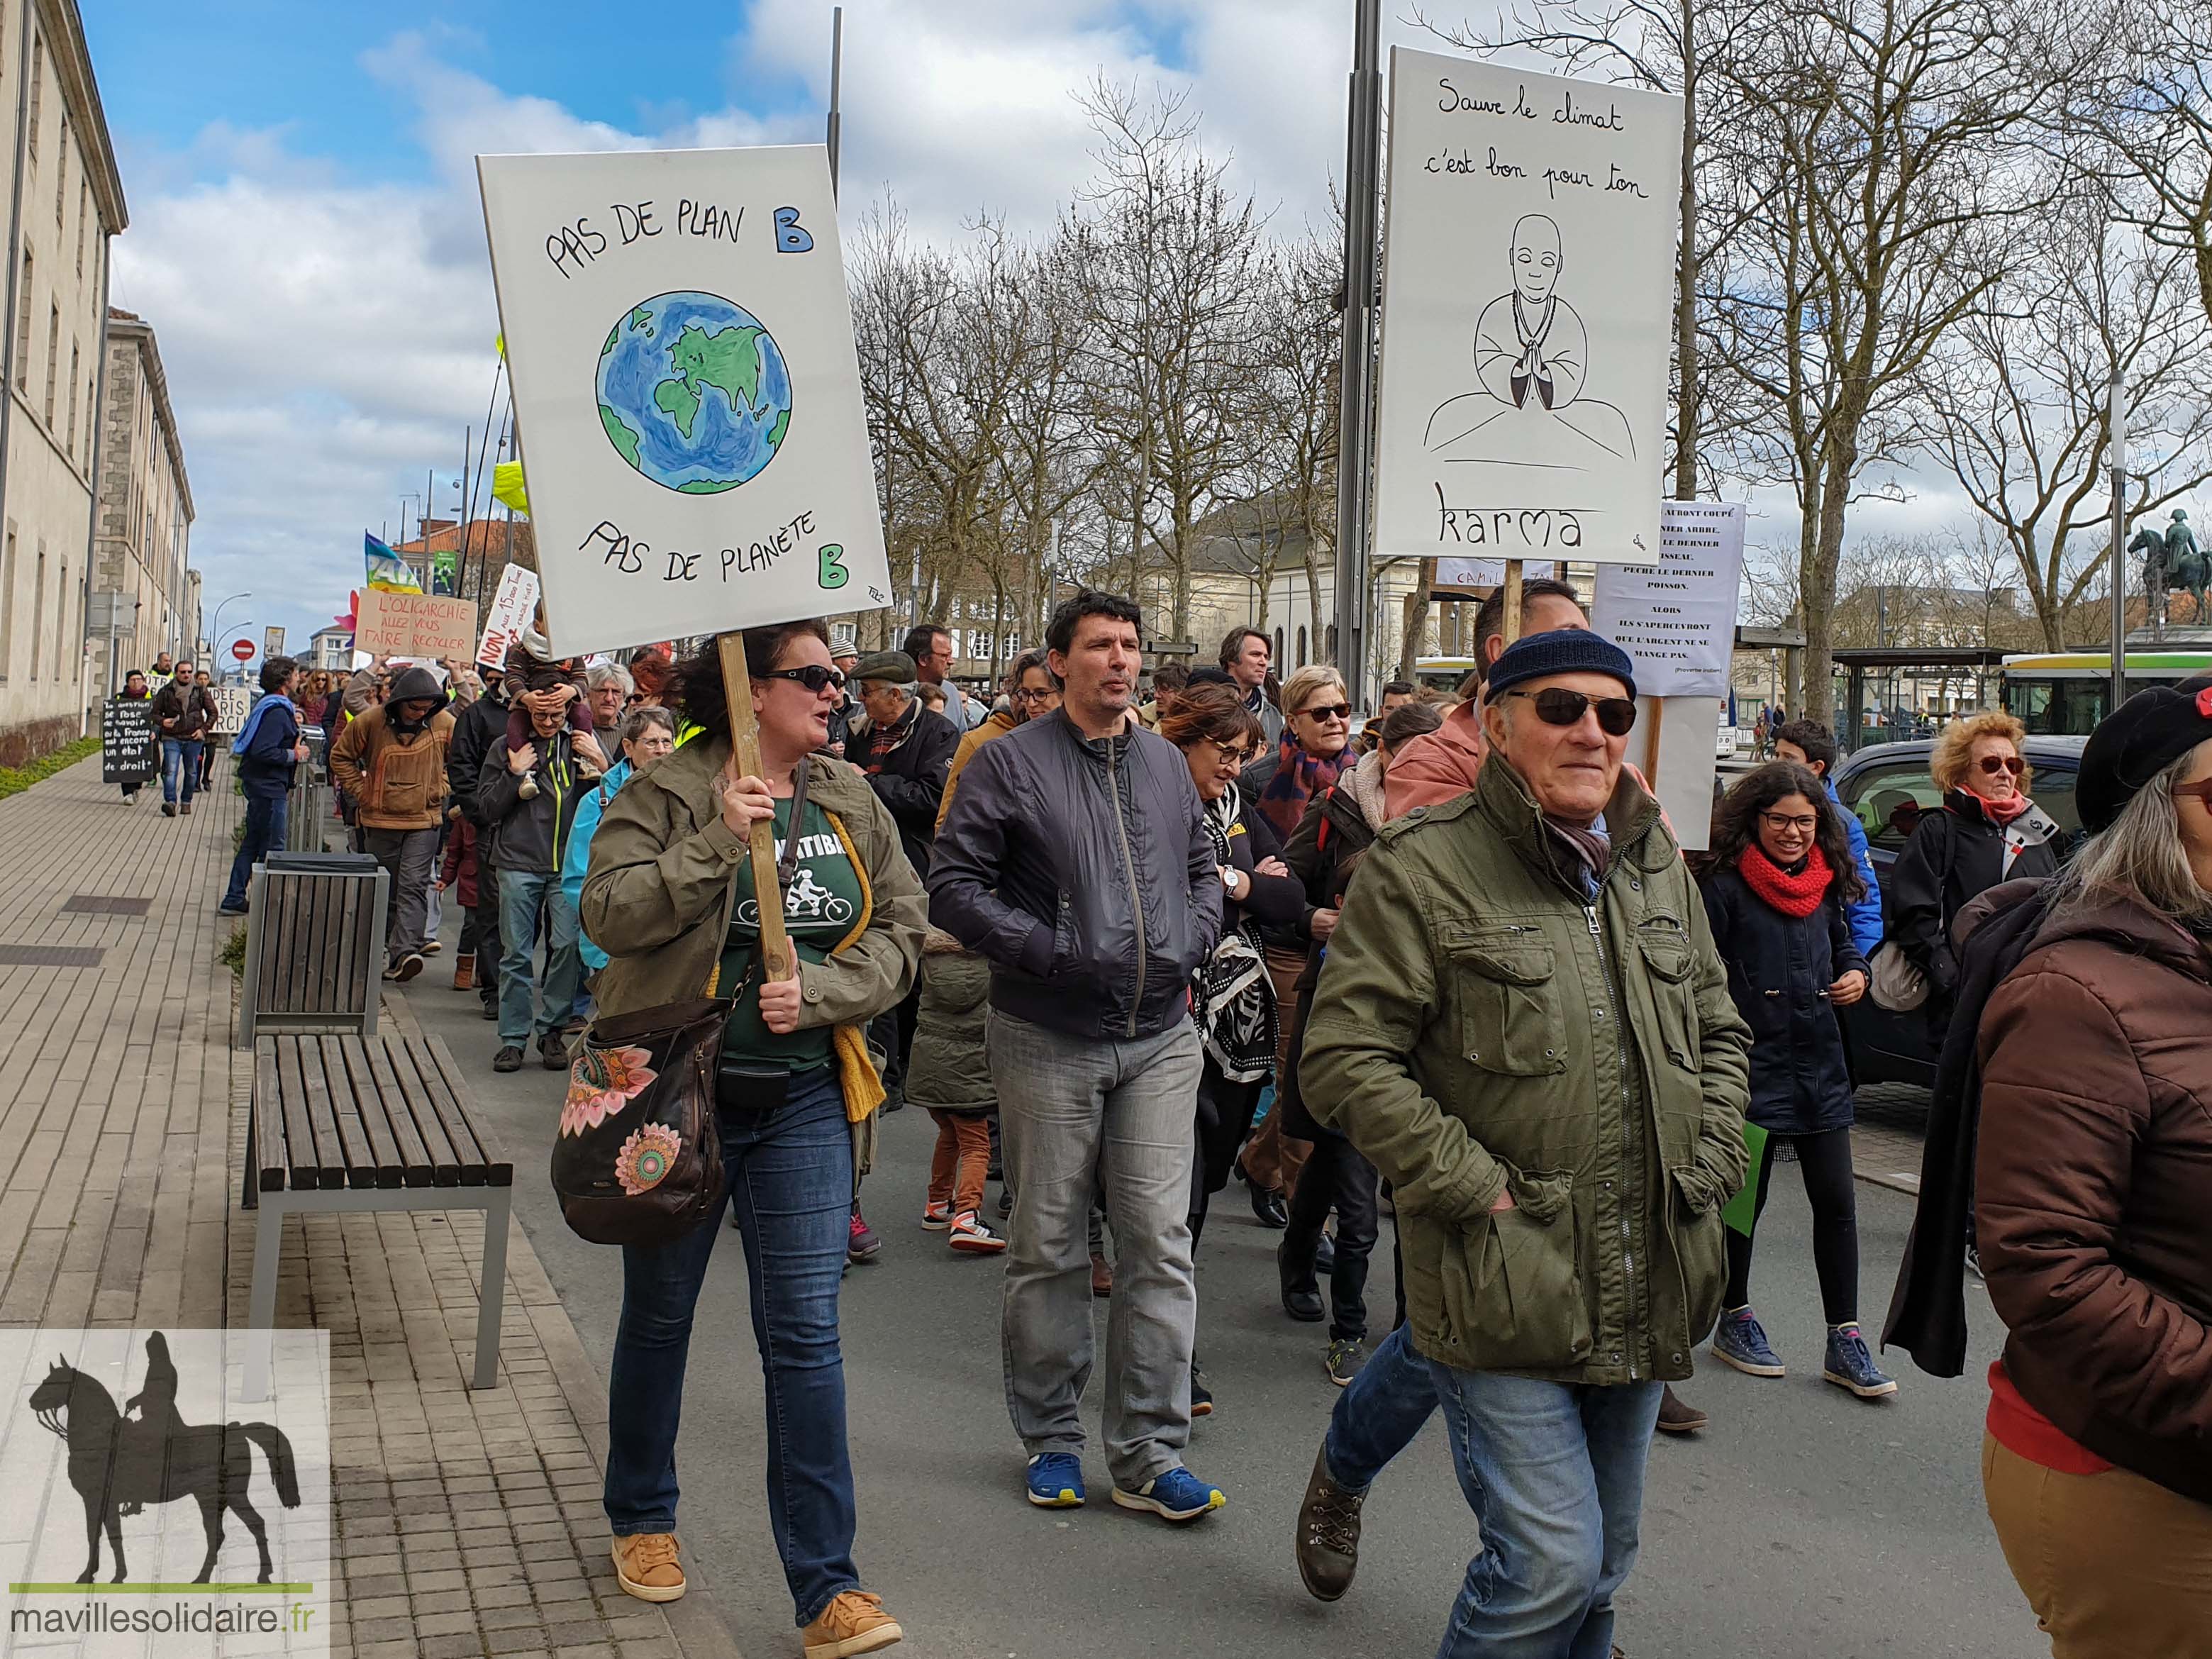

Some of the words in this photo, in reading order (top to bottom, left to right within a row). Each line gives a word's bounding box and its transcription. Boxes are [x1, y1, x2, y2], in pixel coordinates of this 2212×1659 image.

[1438, 79, 1506, 116] Sauve
[1512, 86, 1537, 119] le
[1552, 98, 1625, 132] climat
[1424, 148, 1476, 174] c'est
[1485, 147, 1527, 179] bon
[1543, 167, 1594, 199] pour
[1605, 163, 1650, 199] ton
[545, 218, 607, 279] PAS
[610, 201, 663, 245] DE
[678, 199, 745, 244] PLAN
[773, 206, 813, 253] B
[1435, 482, 1582, 548] karma
[1704, 507, 1735, 517] COUPÉ
[578, 520, 650, 573] PAS
[662, 553, 702, 581] DE
[721, 510, 816, 582] PLANÈTE
[818, 544, 849, 589] B
[381, 616, 409, 628] ALLEZ
[415, 618, 440, 631] VOUS
[1636, 621, 1711, 630] S'APERCEVRONT
[365, 629, 404, 646] FAIRE
[412, 633, 465, 650] RECYCLER
[480, 629, 505, 664] NON
[501, 614, 511, 628] AUX
[120, 736, 149, 745] encore
[124, 728, 150, 737] France
[104, 762, 115, 771] de
